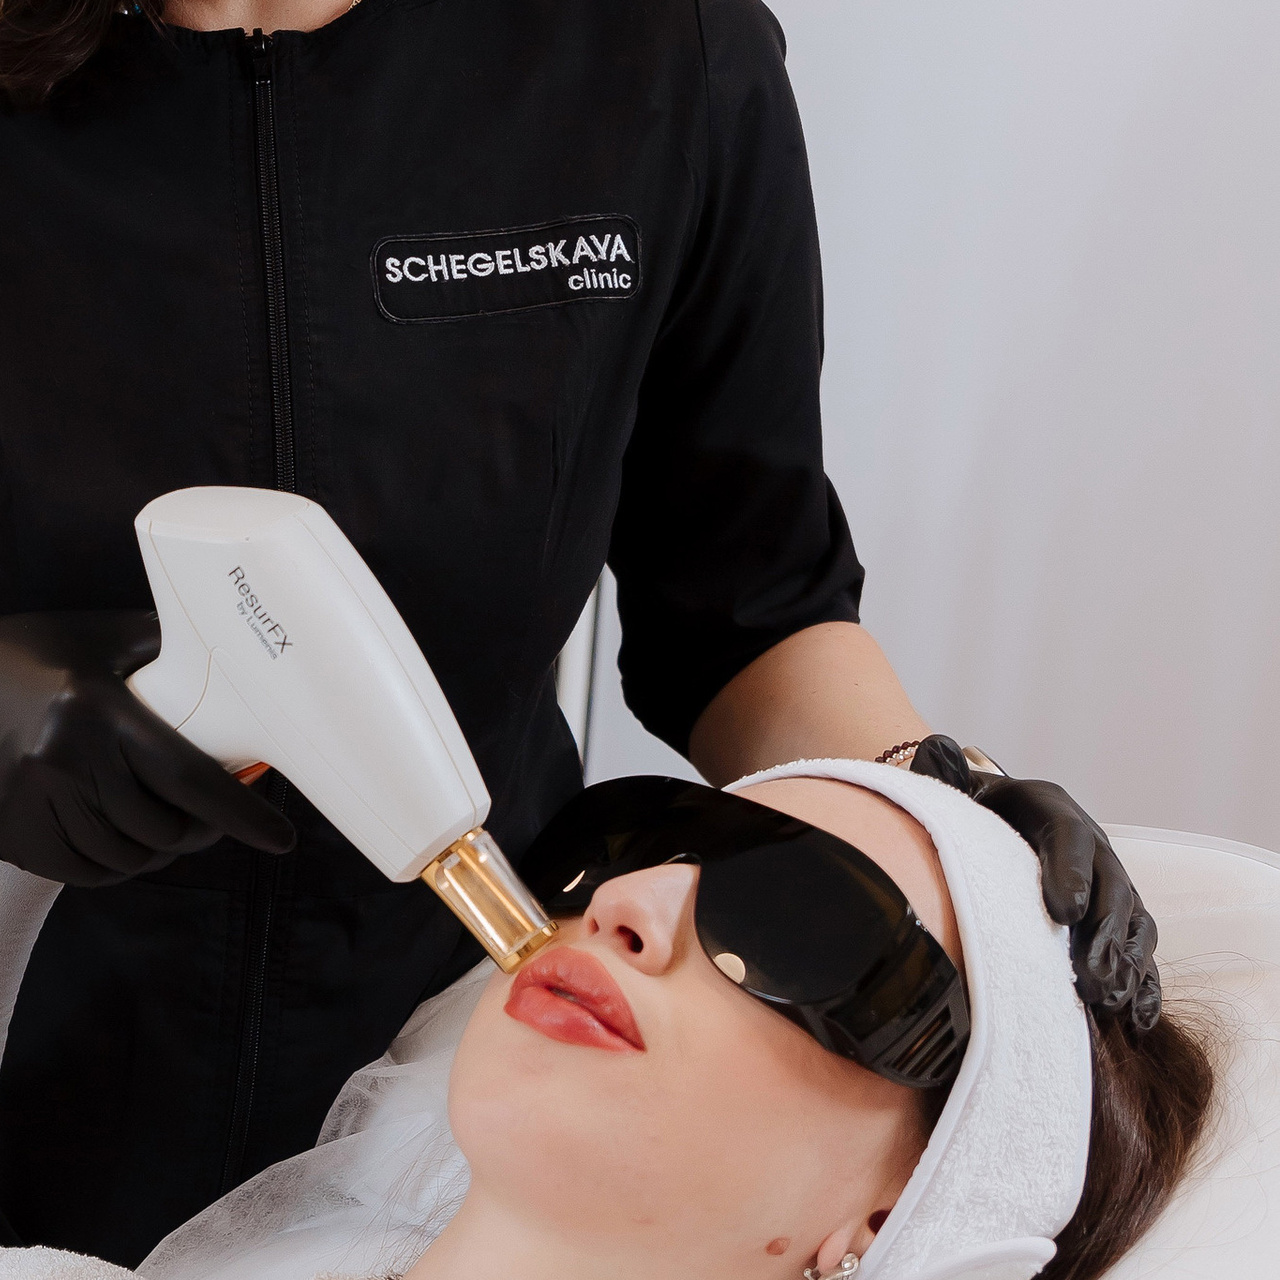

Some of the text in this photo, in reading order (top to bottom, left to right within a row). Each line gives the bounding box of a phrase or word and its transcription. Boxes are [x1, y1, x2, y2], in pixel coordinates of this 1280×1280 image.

[385, 233, 633, 283] SCHEGELSKAYA
[568, 267, 632, 290] clinic
[228, 566, 293, 654] ResurFX
[236, 601, 248, 616] by
